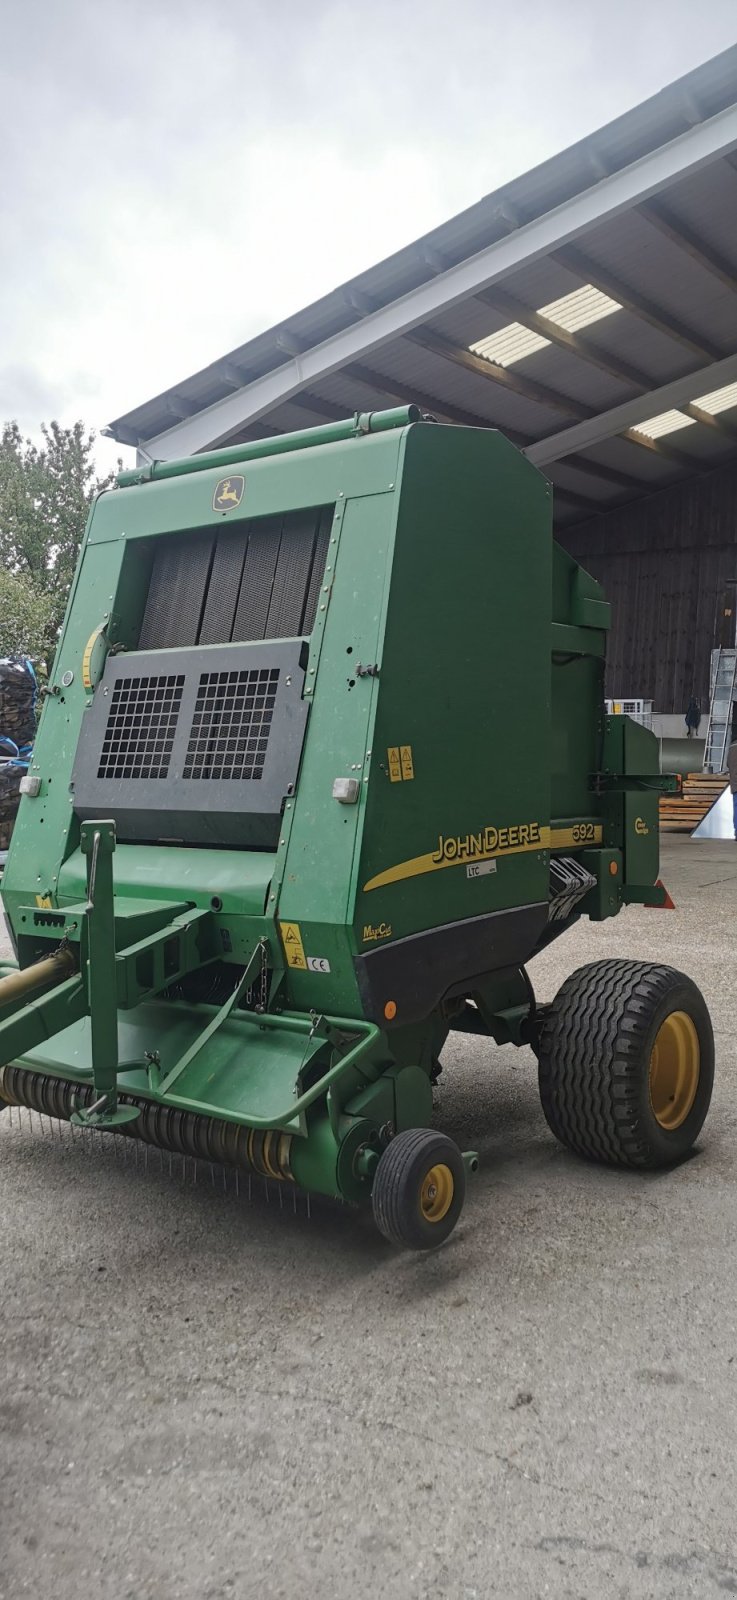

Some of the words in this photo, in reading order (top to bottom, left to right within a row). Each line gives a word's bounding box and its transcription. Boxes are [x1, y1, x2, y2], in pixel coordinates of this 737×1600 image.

[573, 823, 594, 841] 592
[432, 834, 483, 863] JOHN
[484, 823, 539, 850] DEERE
[468, 866, 480, 877] LTC
[311, 958, 327, 971] CE
